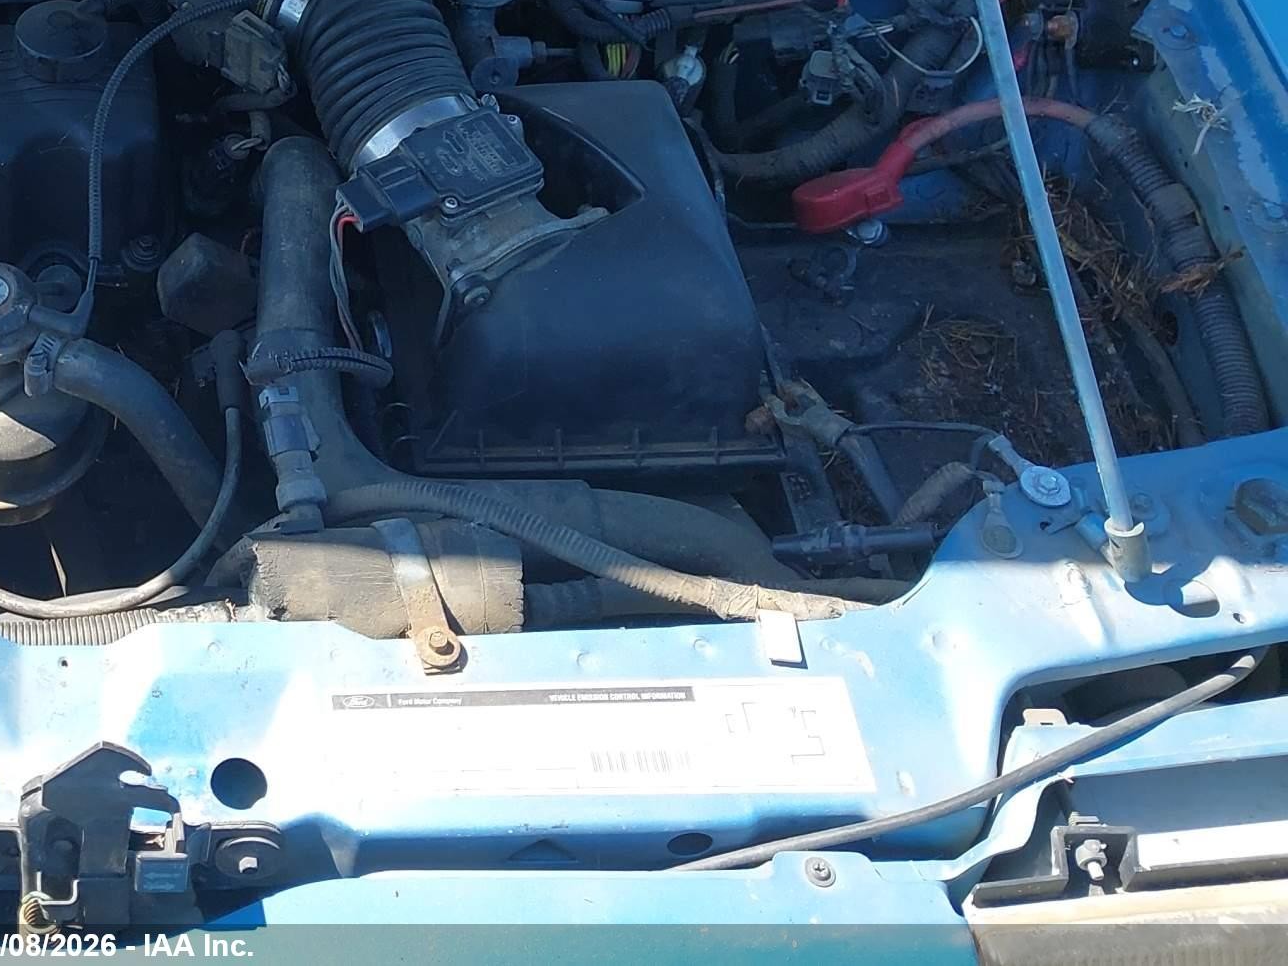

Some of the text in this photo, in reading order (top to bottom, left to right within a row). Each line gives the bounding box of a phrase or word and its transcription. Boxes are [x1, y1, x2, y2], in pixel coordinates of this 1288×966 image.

[398, 698, 412, 706] Ford
[414, 698, 431, 706] Motor
[433, 697, 462, 706] Company
[549, 692, 686, 702] VEHICLE EMISSION CONTROL INFORMATION
